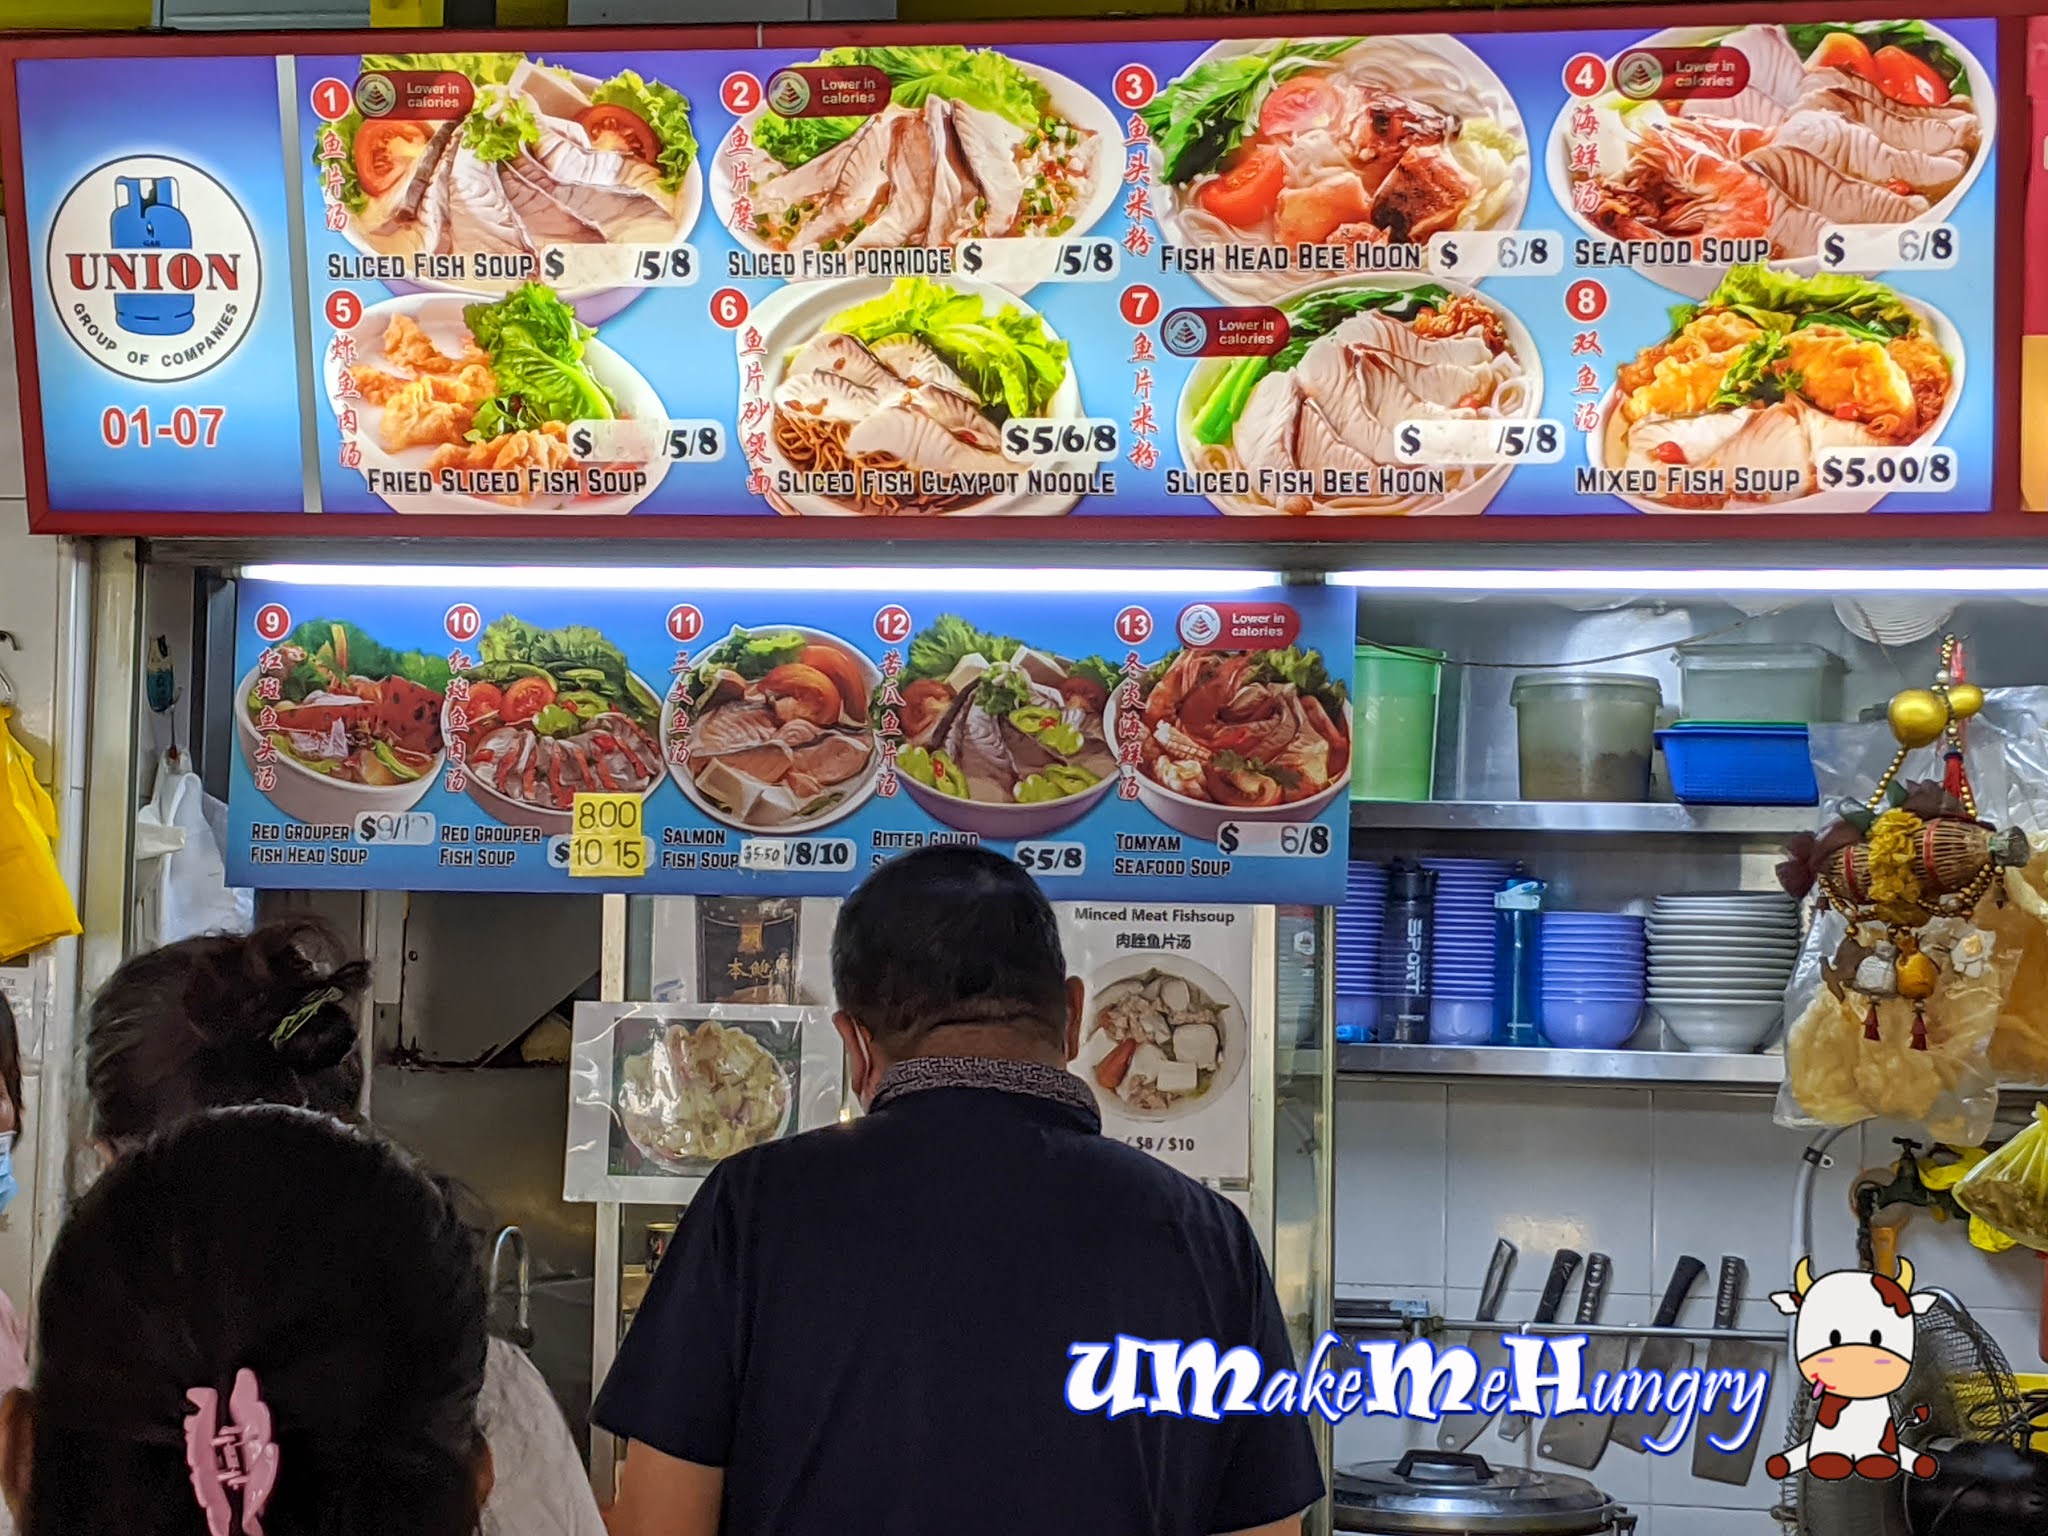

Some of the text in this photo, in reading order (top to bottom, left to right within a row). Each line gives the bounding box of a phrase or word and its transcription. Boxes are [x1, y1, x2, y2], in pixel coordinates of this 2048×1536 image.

[1574, 62, 1595, 89] 4
[1675, 60, 1735, 73] Lower in
[407, 83, 460, 94] Lower in
[732, 81, 750, 107] 2
[821, 79, 875, 90] Lower in
[1125, 73, 1142, 100] 3
[1675, 75, 1734, 87] calories
[323, 87, 336, 112] 1
[407, 96, 460, 108] calories
[822, 93, 875, 104] calories
[1569, 104, 1601, 213] 海鲜汤
[319, 130, 349, 232] 鱼片汤
[1123, 113, 1155, 256] 鱼头米粉
[728, 248, 951, 276] SLICED FISH PORRIDGE
[1161, 243, 1421, 271] FISH HEAD BEE HOON
[1575, 237, 1769, 265] SEAFOOD SOUP
[65, 253, 241, 291] UNION
[328, 253, 533, 279] SLICED FISH SOUP
[336, 298, 351, 322] 5
[720, 295, 737, 321] 6
[1131, 292, 1149, 317] 7
[1578, 288, 1595, 314] 8
[73, 303, 238, 367] GROUP OF COMPANIES
[1219, 319, 1275, 331] Lower in
[1219, 333, 1274, 344] calories
[1571, 331, 1603, 432] 双鱼汤
[331, 335, 361, 468] 炸鱼肉汤
[739, 326, 772, 494] 鱼片砂煲面
[1127, 332, 1159, 469] 鱼片米粉
[102, 407, 225, 446] 01-07
[1006, 425, 1117, 455] $5/6/8
[367, 468, 646, 494] FRIED SLICED FISH SOUP
[778, 469, 1115, 494] SLICED FISH CLAYPOT NOODLE
[1166, 468, 1444, 494] SLICED FISH BEE HOON
[1576, 466, 1799, 494] MIXED FISH SOUP
[1822, 453, 1951, 488] $5.00/8
[265, 613, 280, 633] 9
[449, 611, 476, 634] 10
[671, 611, 697, 634] 11
[879, 613, 907, 635] 12
[1120, 613, 1149, 636] 13
[1232, 612, 1285, 624] Lower in
[1231, 626, 1284, 637] calories
[256, 647, 283, 792] 红斑鱼头汤
[445, 649, 472, 792] 红斑鱼肉汤
[668, 651, 694, 766] 三文鱼汤
[877, 648, 905, 797] 苦瓜鱼片汤
[578, 800, 637, 830] 8.00
[574, 838, 642, 869] 10 15
[1016, 847, 1082, 870] $5/8
[1074, 907, 1235, 926] Minced Meat Fishsoup
[1168, 1136, 1195, 1151] $10
